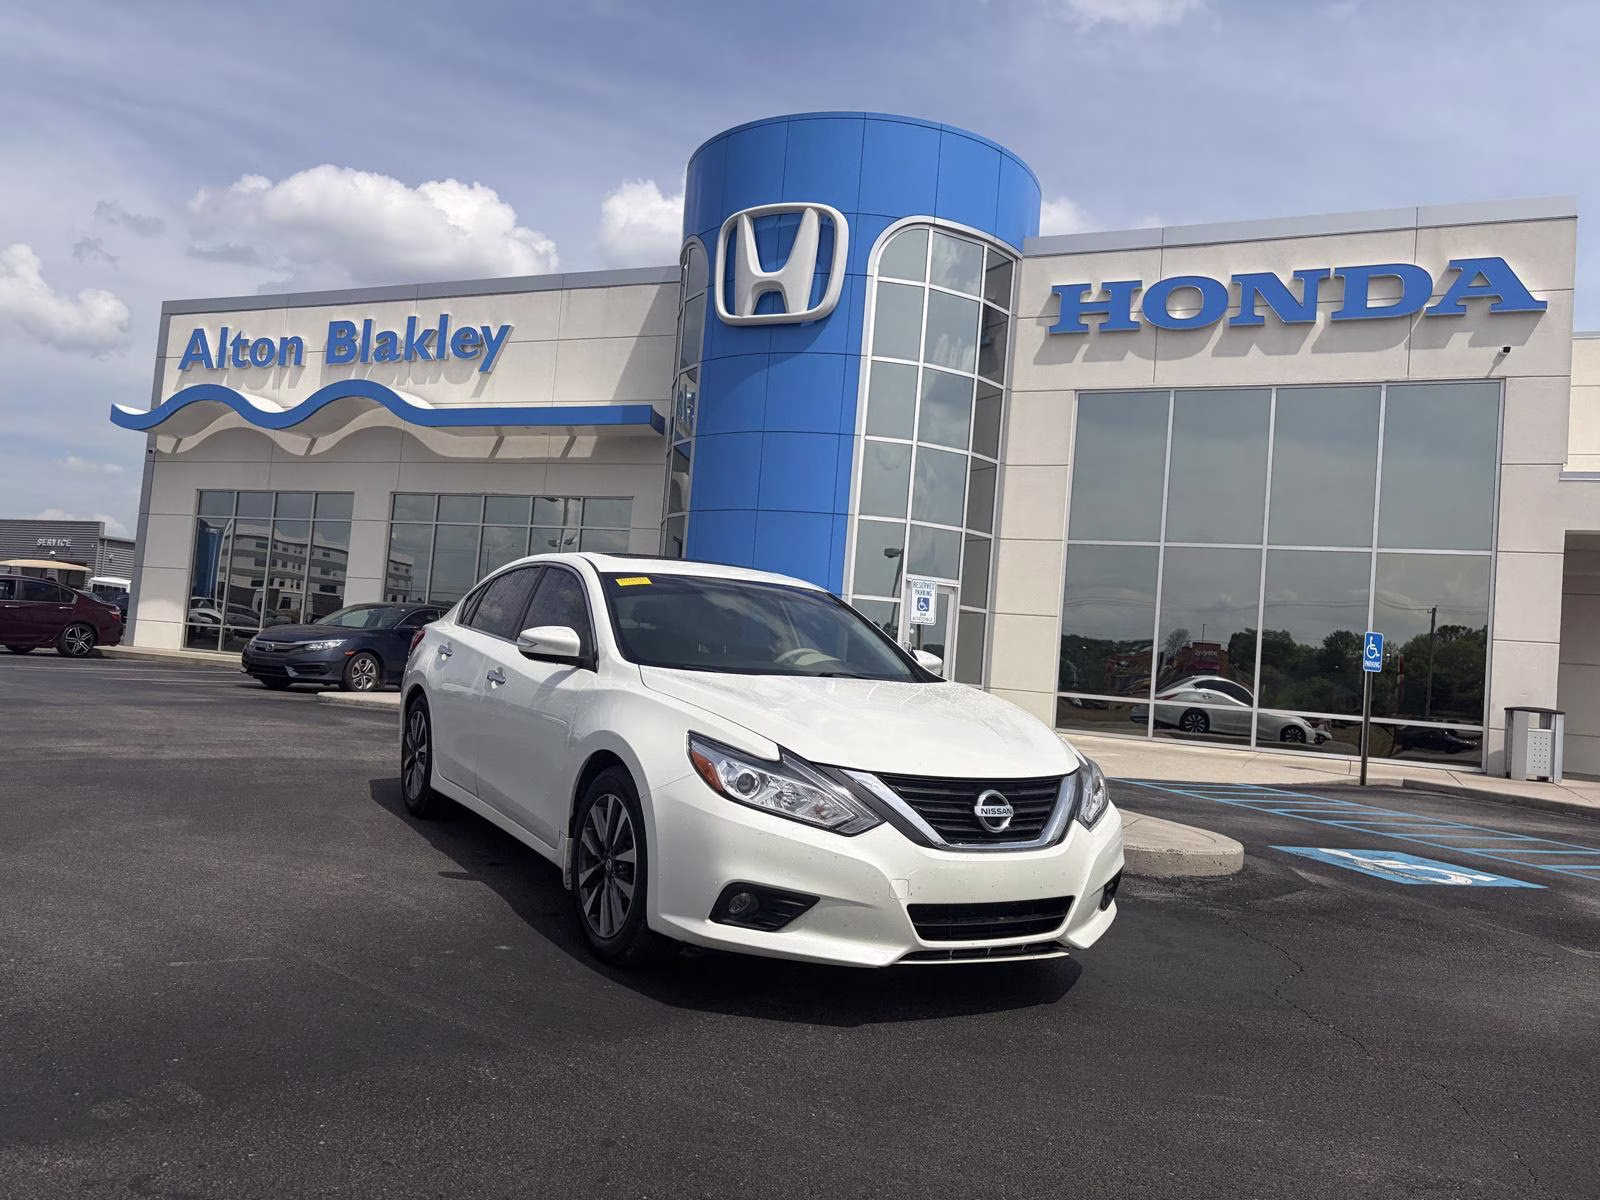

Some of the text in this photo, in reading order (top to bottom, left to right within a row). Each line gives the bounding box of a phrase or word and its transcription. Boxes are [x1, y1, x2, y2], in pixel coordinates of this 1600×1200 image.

[1049, 257, 1548, 334] HONDA
[178, 313, 514, 374] Alton Blakley
[37, 538, 71, 547] SERVICE
[914, 589, 933, 597] PARKING
[980, 807, 1012, 815] NISSAN
